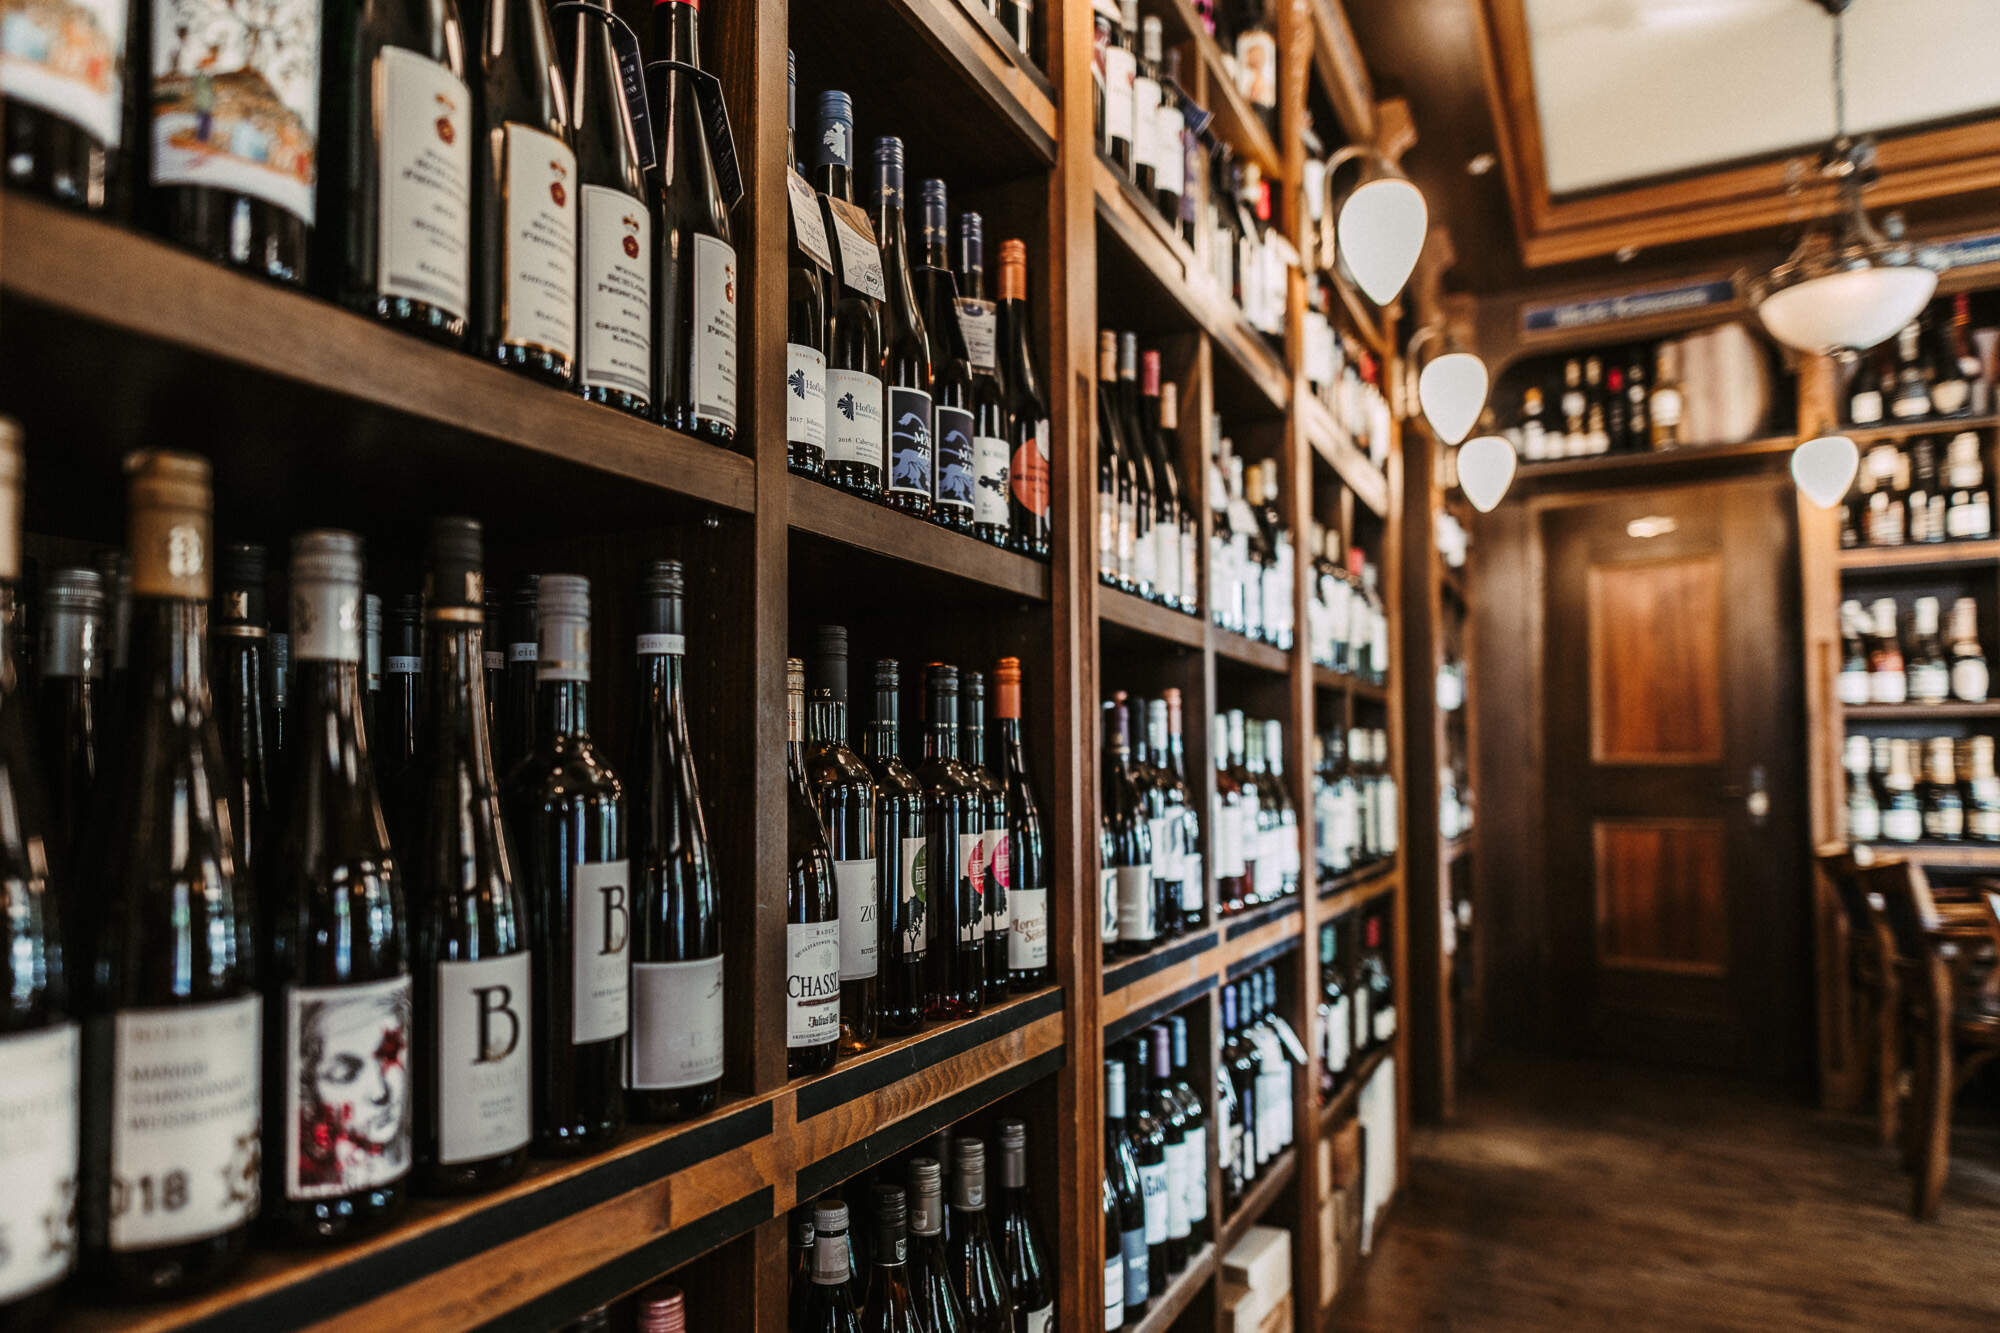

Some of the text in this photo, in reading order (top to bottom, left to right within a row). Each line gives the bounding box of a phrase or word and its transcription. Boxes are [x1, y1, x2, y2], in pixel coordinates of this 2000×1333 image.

[866, 275, 878, 285] BIO
[598, 885, 629, 956] B
[471, 984, 520, 1066] B
